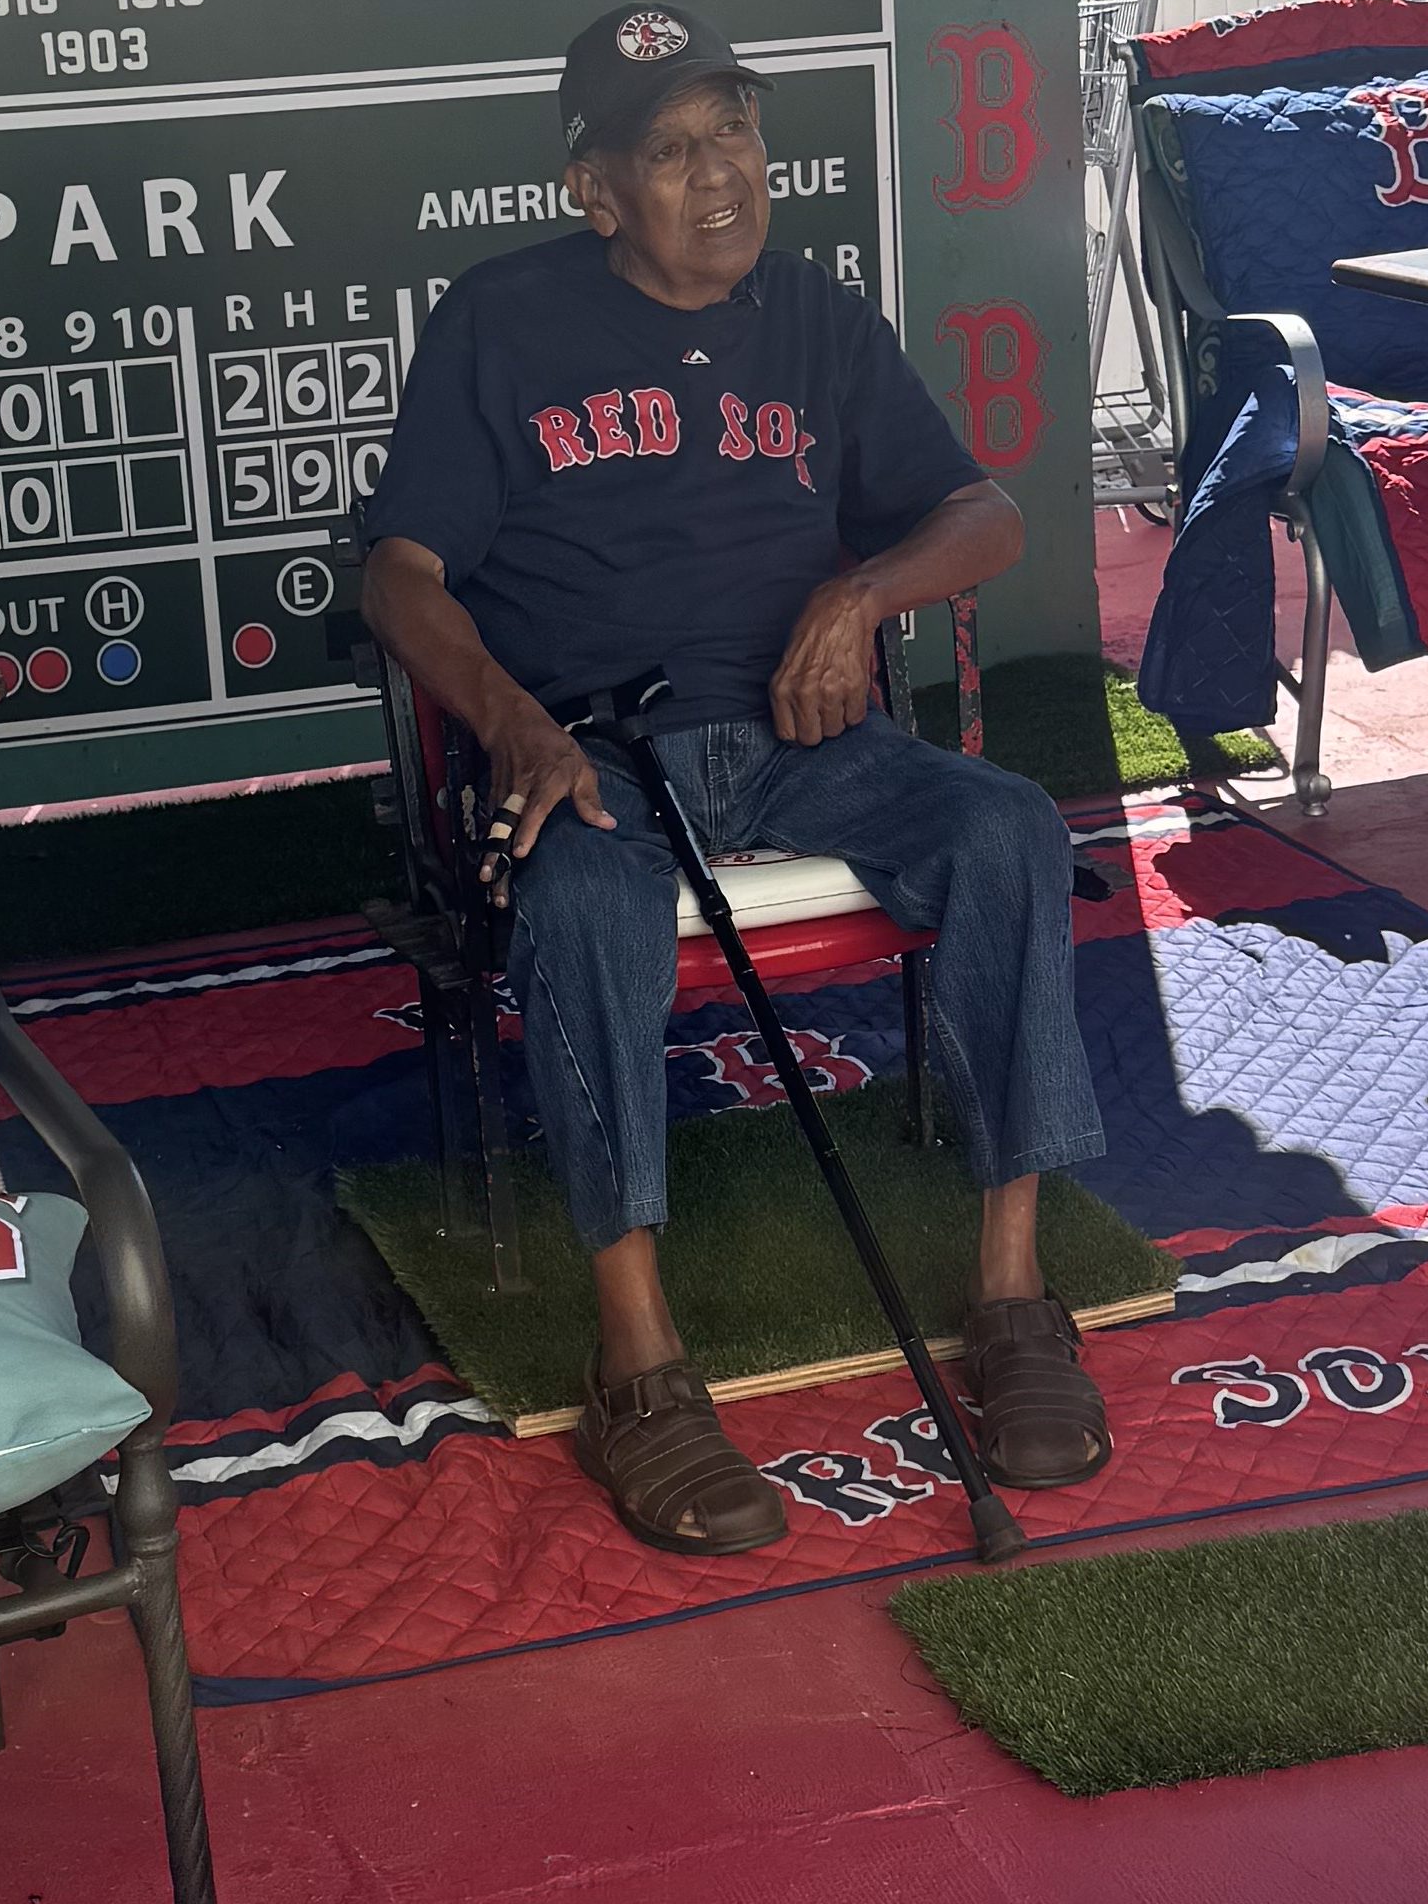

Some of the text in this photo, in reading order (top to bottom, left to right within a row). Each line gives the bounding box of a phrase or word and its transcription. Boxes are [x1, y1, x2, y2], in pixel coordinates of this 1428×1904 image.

[40, 27, 149, 77] 1903
[925, 20, 1052, 215] B
[836, 244, 862, 281] R
[64, 310, 96, 354] 9
[112, 304, 174, 350] 10
[225, 294, 255, 332] R
[283, 289, 315, 328] H
[345, 284, 370, 322] E
[0, 383, 43, 442] 0
[68, 377, 99, 435] 1
[223, 363, 265, 422] 2
[285, 358, 327, 416] 6
[345, 352, 386, 411] 2
[528, 387, 681, 473] RED
[934, 299, 1058, 481] B
[9, 477, 52, 536] 0
[234, 454, 271, 513] 5
[291, 449, 332, 507] 9
